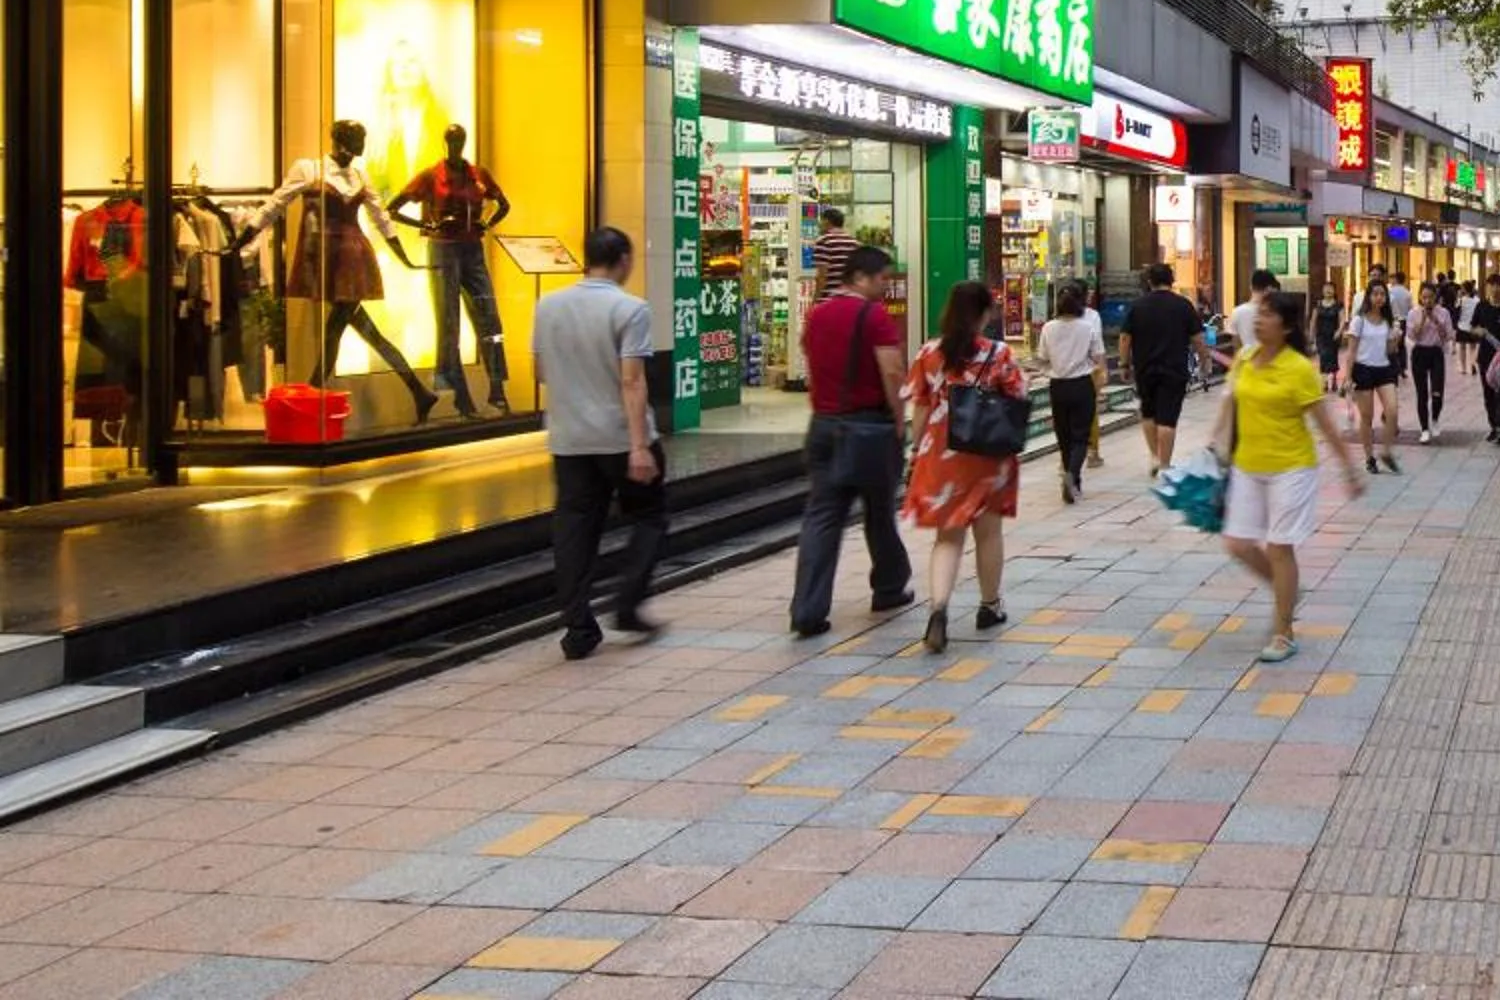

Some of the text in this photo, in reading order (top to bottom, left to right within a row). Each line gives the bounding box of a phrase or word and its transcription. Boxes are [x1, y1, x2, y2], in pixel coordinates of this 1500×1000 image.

[1330, 64, 1363, 167] 眼镜城
[675, 57, 698, 399] 医保定点药店
